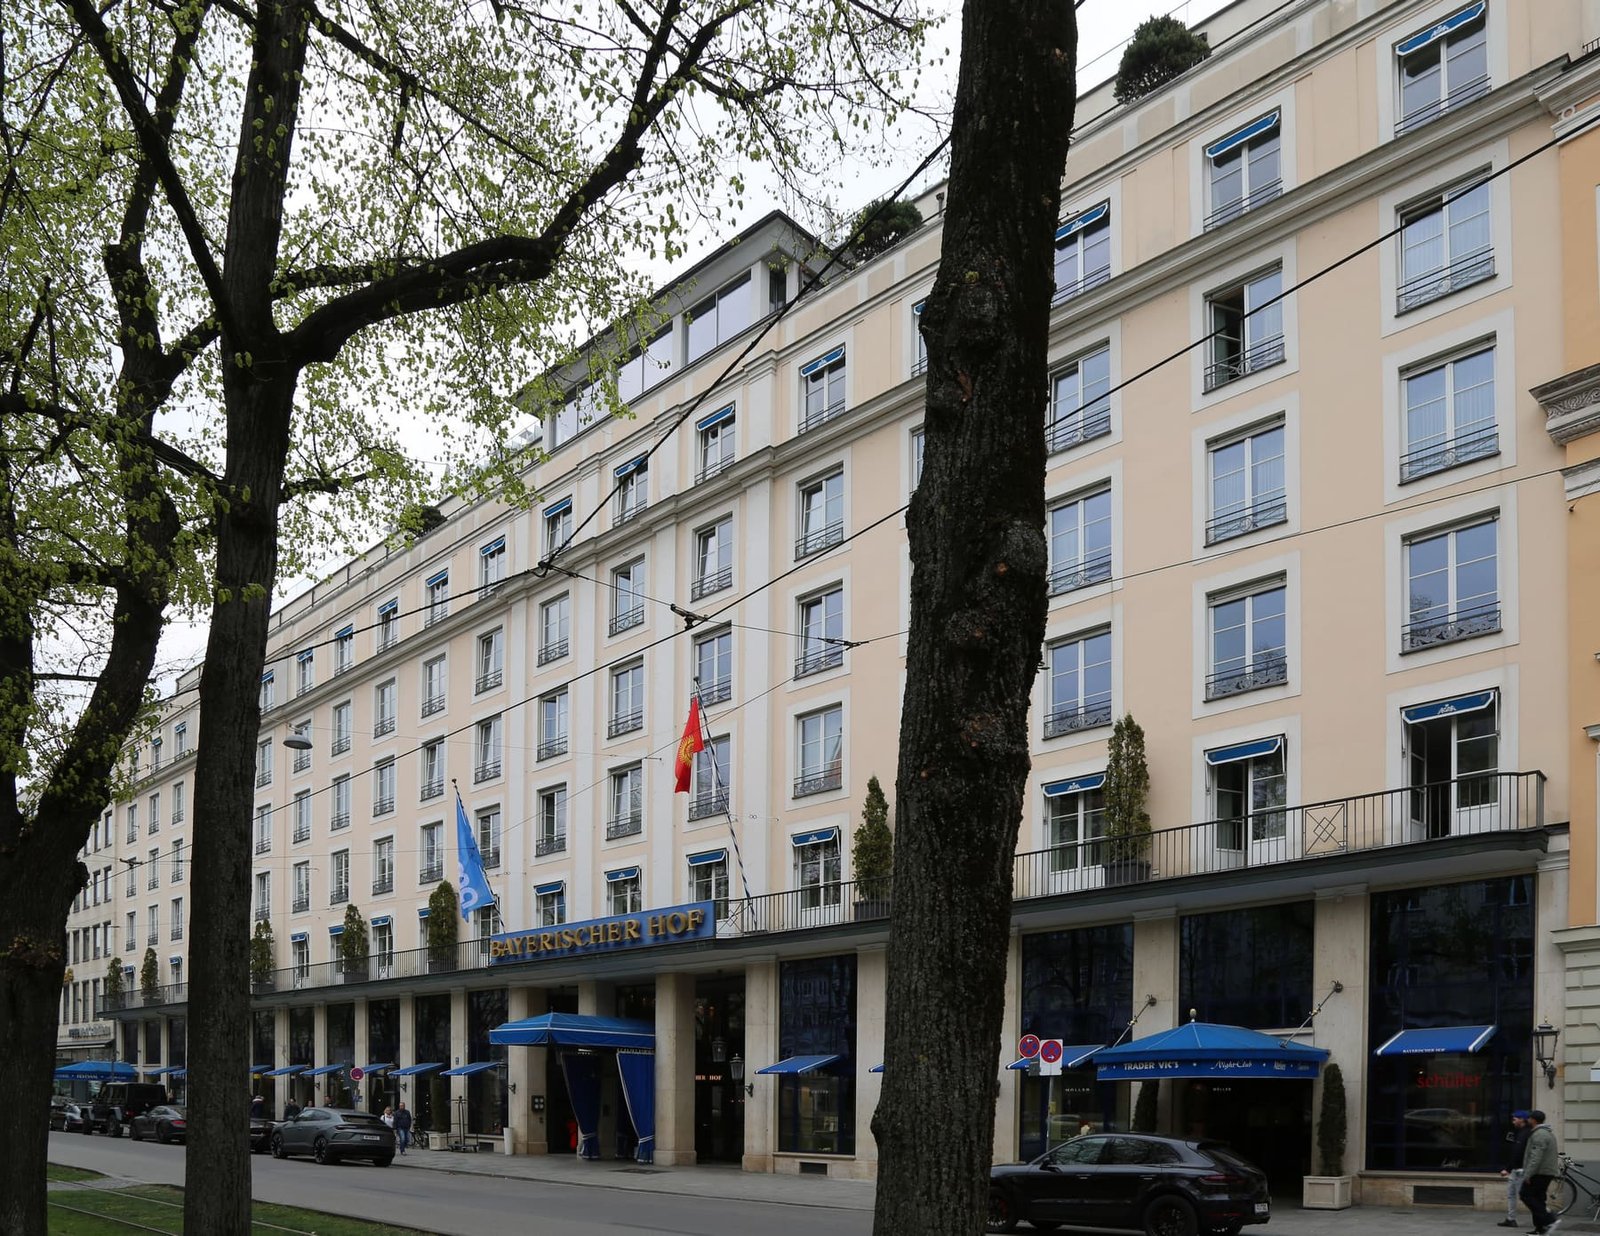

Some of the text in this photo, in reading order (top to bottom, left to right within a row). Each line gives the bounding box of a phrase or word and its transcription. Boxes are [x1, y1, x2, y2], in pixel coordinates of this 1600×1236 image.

[490, 908, 705, 957] BAYERISCHER HOF
[1123, 1060, 1180, 1071] TRADER VIC'S
